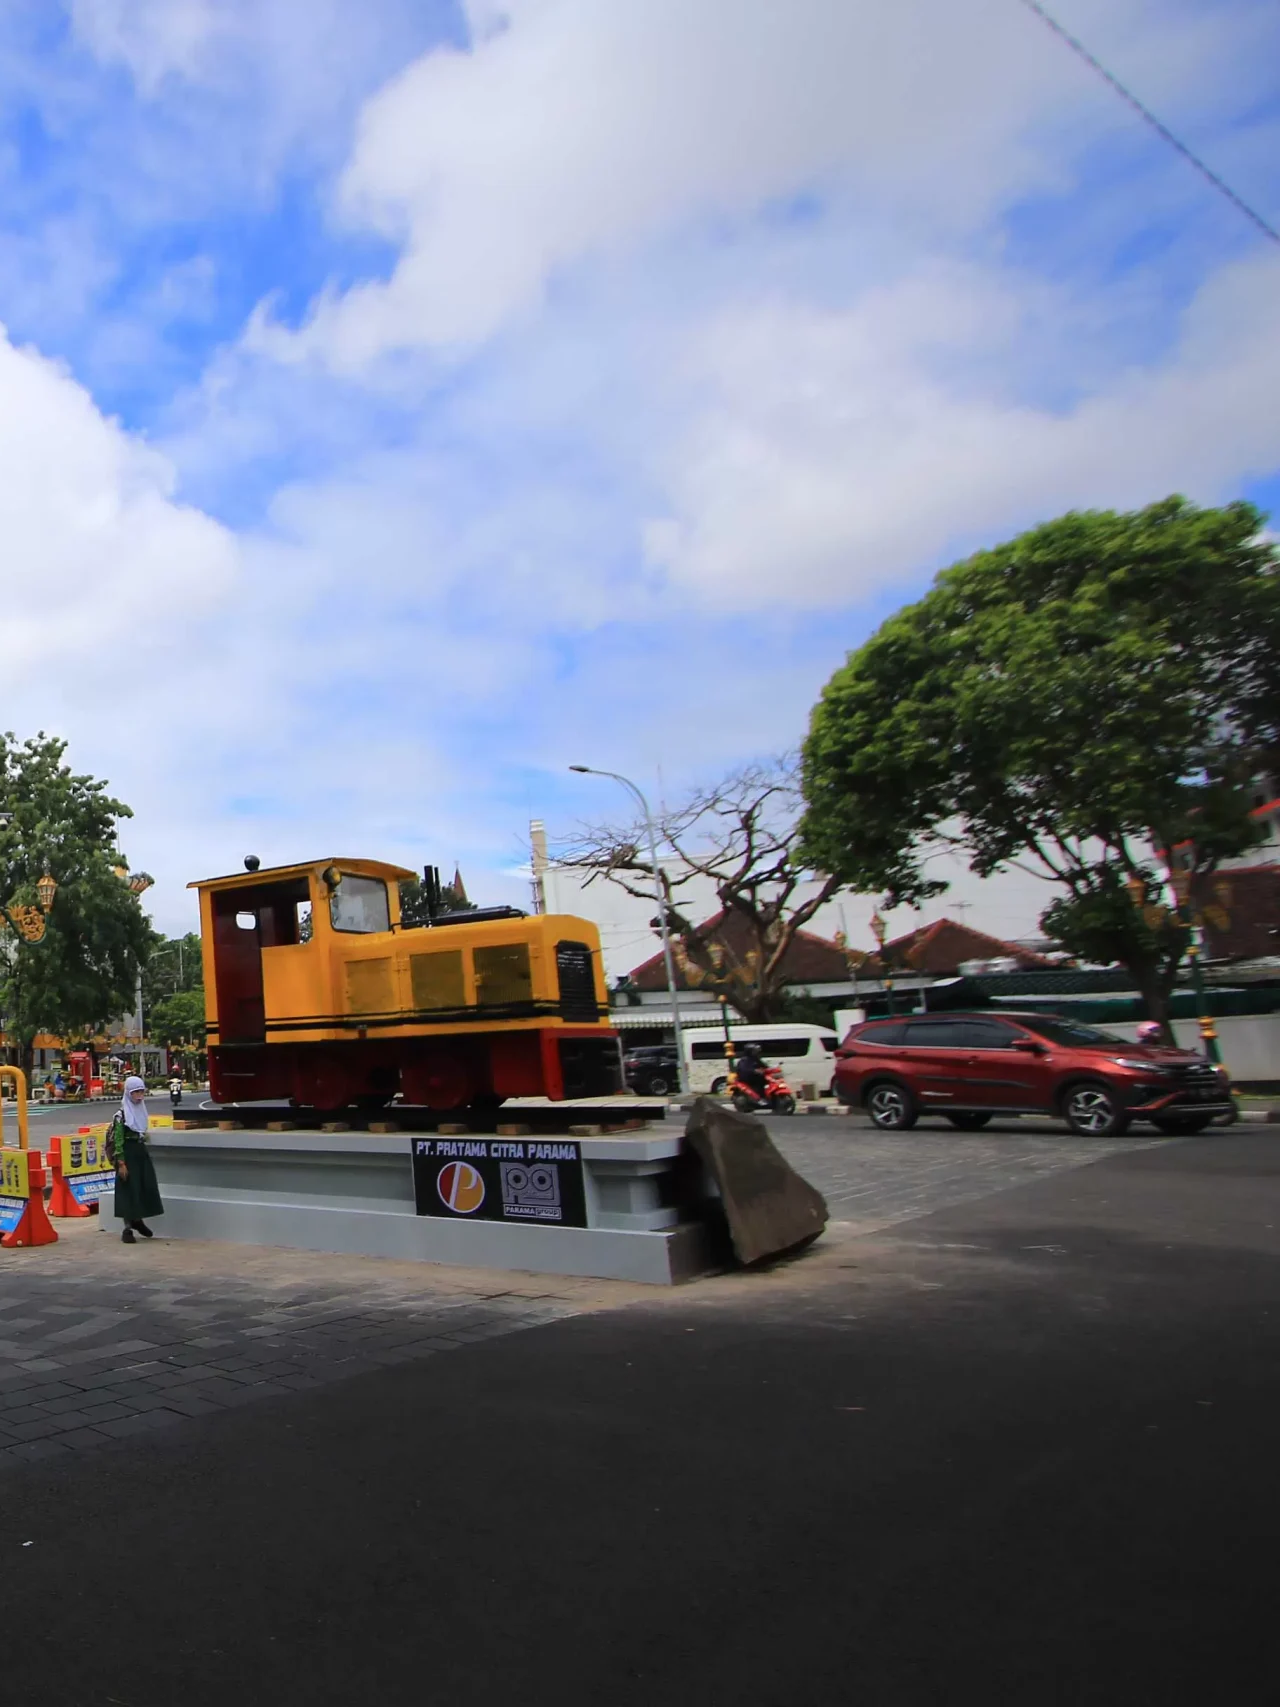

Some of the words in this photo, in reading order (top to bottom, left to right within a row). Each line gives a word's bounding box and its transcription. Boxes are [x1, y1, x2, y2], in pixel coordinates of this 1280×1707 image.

[416, 1141, 434, 1155] PT.
[437, 1142, 487, 1157] PRATAMA
[527, 1144, 577, 1160] PARAMA
[505, 1206, 535, 1215] PARAMA
